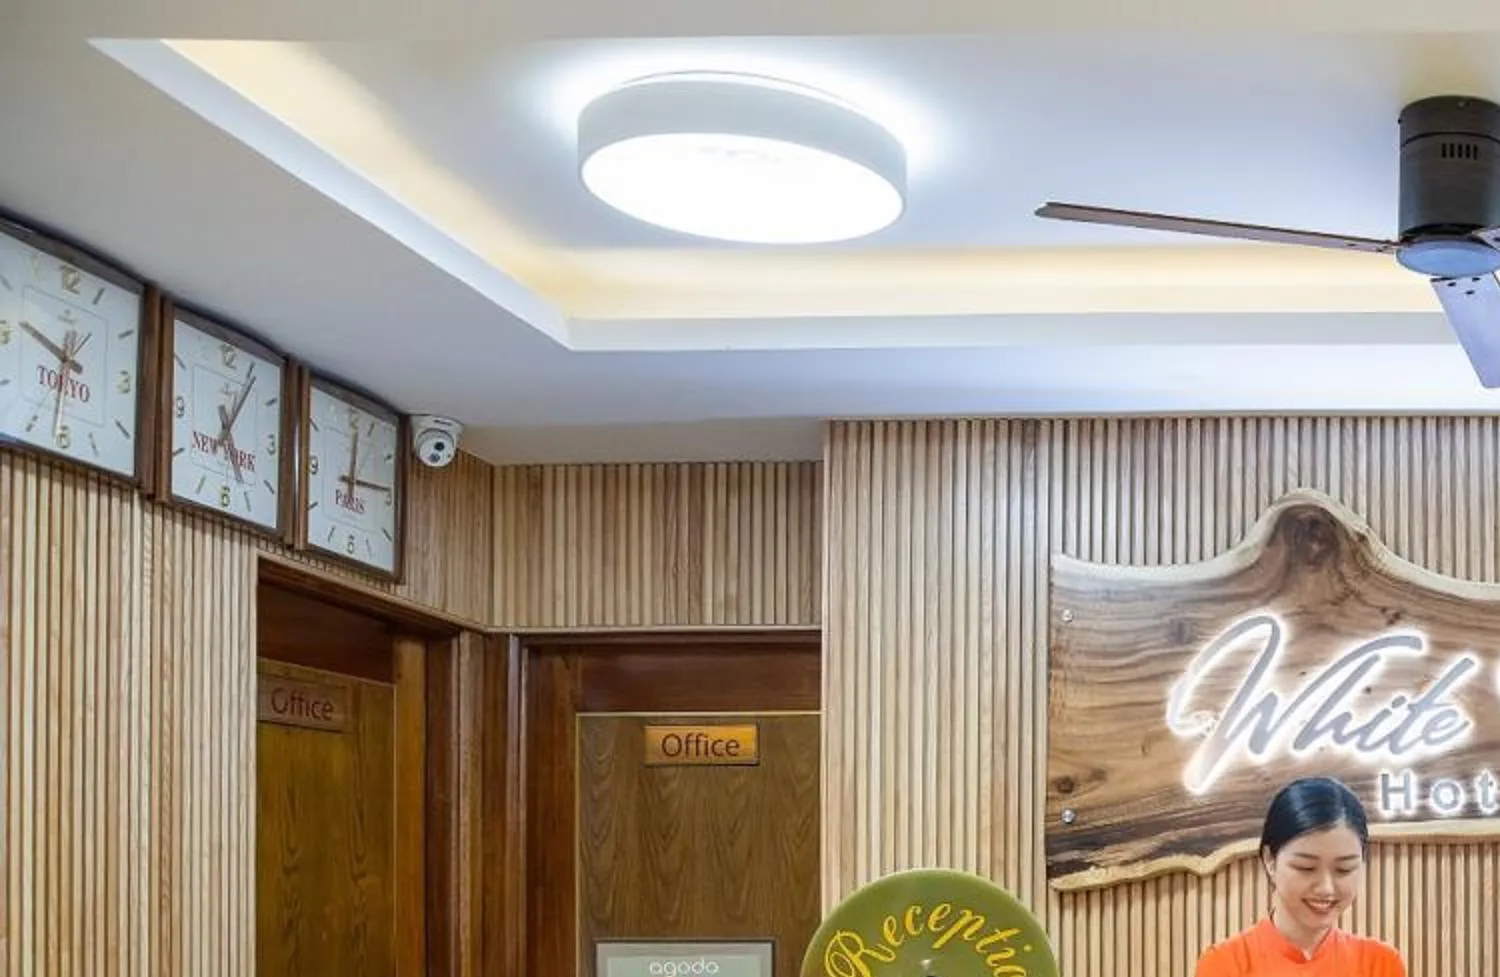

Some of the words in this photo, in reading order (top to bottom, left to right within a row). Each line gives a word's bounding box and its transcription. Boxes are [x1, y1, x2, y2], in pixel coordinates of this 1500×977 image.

[192, 430, 222, 456] NEW
[271, 687, 334, 720] Office
[1168, 612, 1477, 793] White
[661, 732, 739, 757] Office
